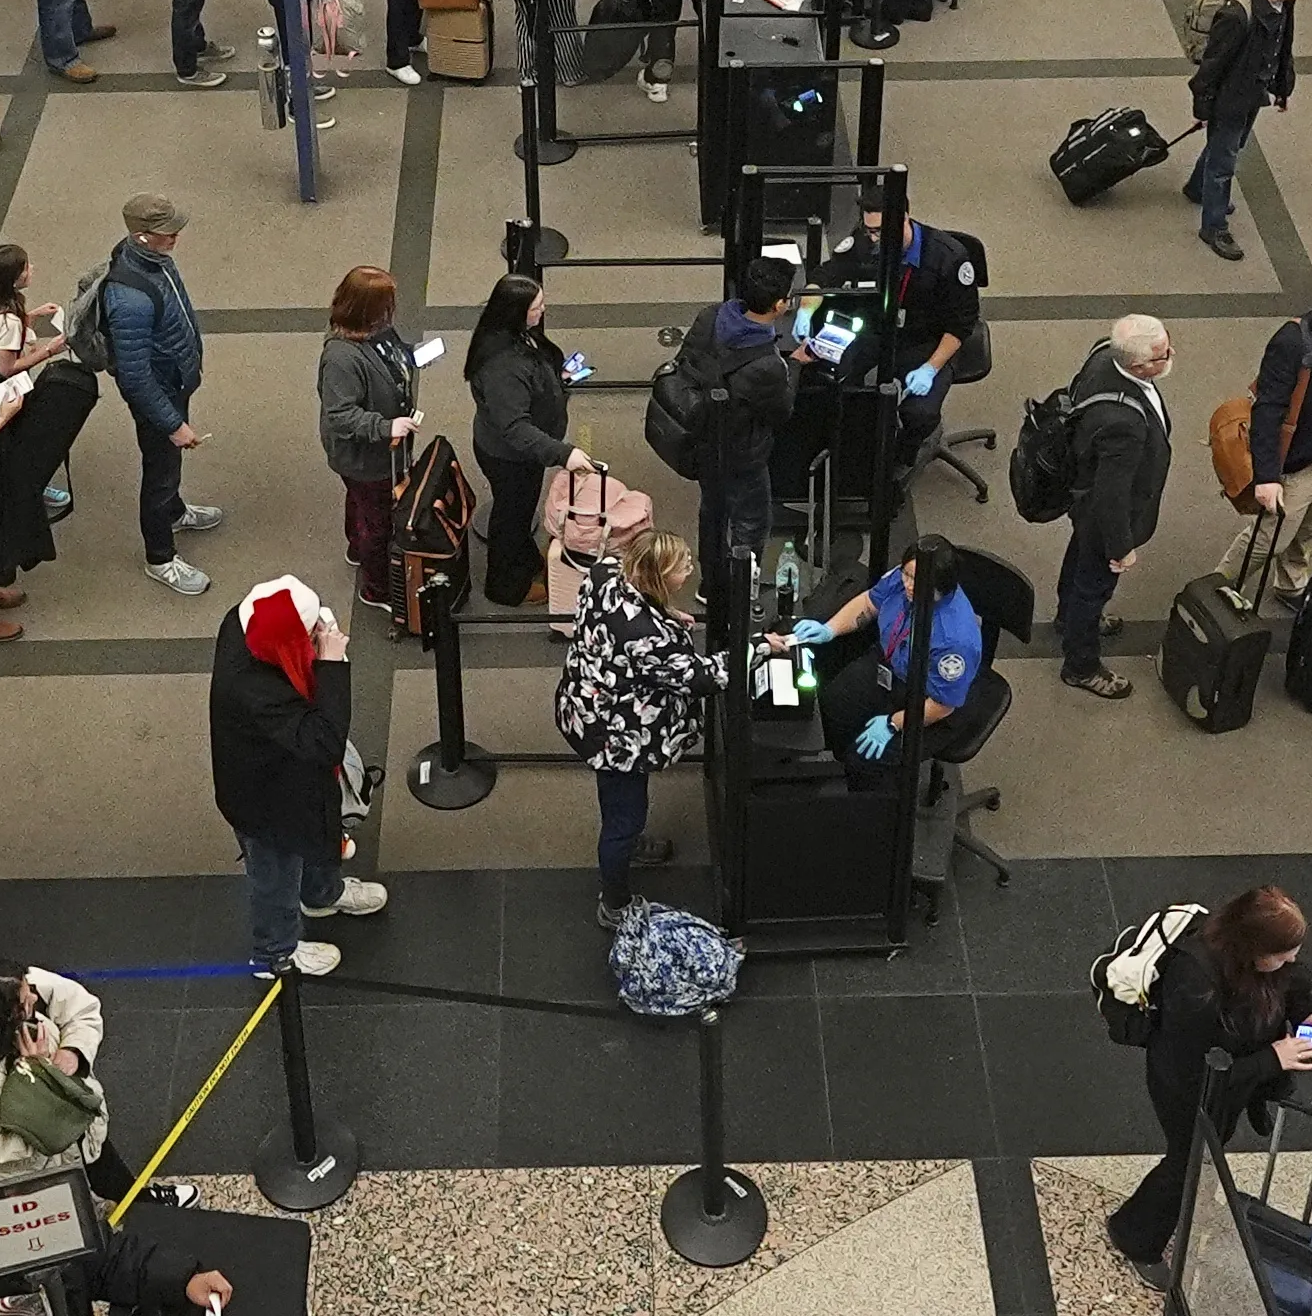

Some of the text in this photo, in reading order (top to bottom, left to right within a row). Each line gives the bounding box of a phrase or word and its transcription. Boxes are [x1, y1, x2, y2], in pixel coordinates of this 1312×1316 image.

[184, 1085, 209, 1121] CAUTION
[231, 1028, 249, 1057] ENTER
[12, 1200, 38, 1214] ID
